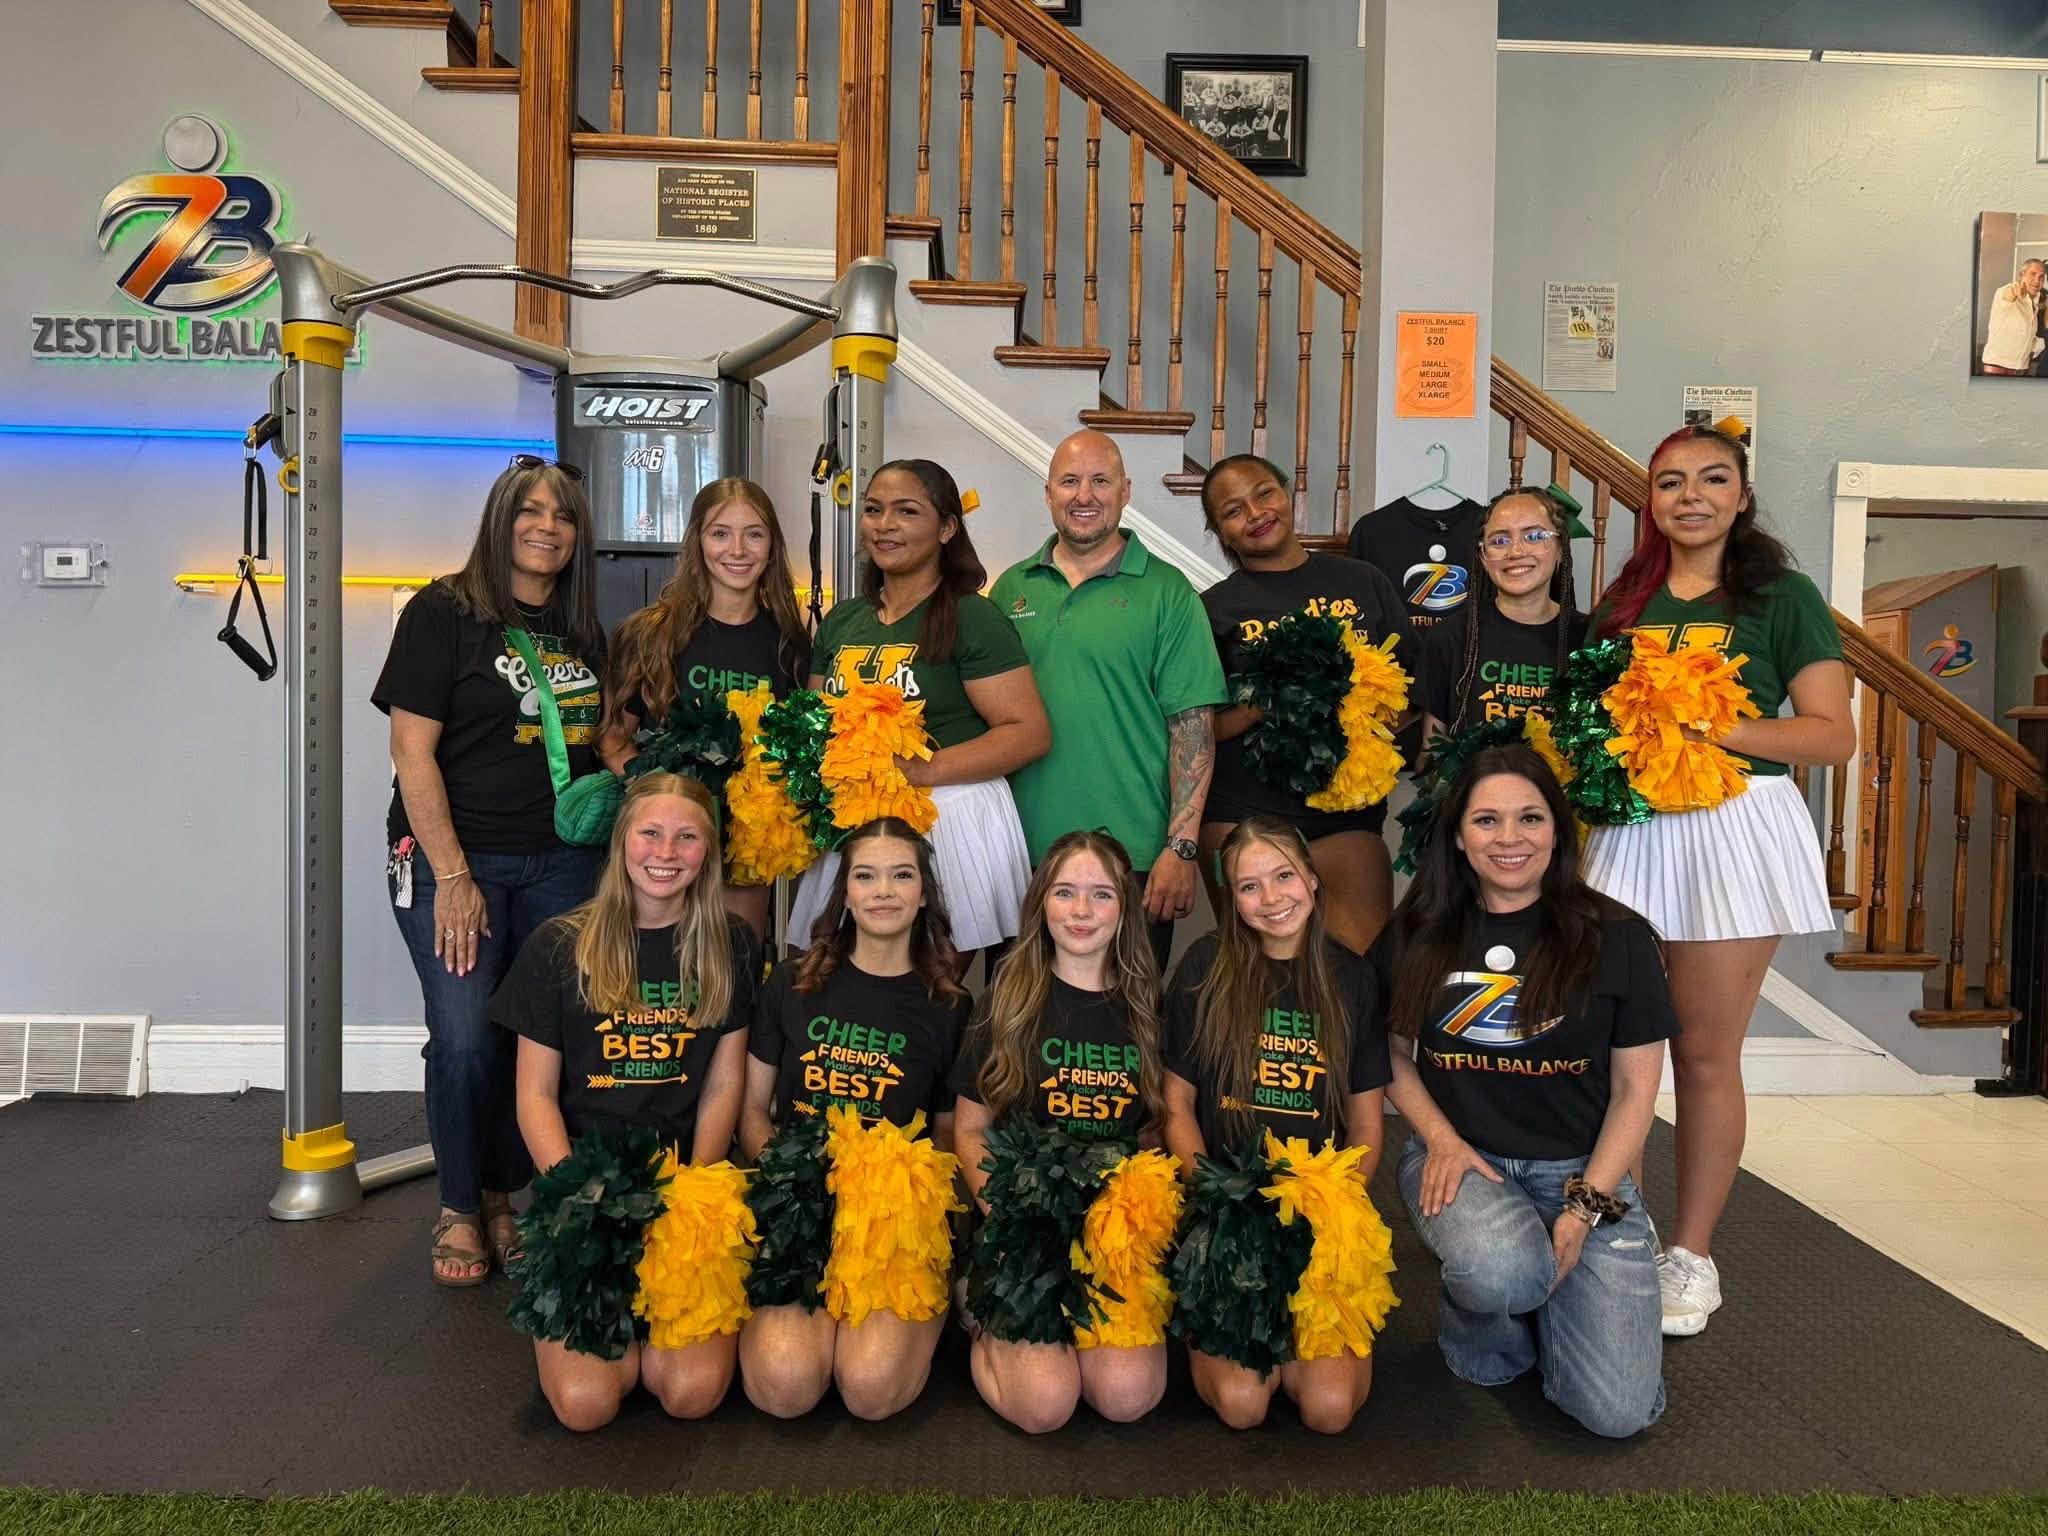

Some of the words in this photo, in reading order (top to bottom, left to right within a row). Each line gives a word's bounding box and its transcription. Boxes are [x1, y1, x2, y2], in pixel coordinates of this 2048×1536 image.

[664, 187, 706, 196] NATIONAL
[708, 189, 749, 197] REGISTER
[33, 315, 184, 354] ZESTFUL
[1426, 336, 1445, 346] $20
[1422, 360, 1448, 368] SMALL
[584, 396, 712, 420] HOIST
[308, 432, 317, 440] 27
[624, 446, 665, 472] Mi6
[308, 504, 317, 512] 24
[308, 552, 317, 560] 22
[1480, 661, 1554, 685] CHEE
[614, 1007, 688, 1025] FRIENDS
[623, 1025, 654, 1034] Make
[807, 1016, 907, 1055] CHEER
[603, 1033, 696, 1059] BEST
[818, 1043, 889, 1068] FRIENDS
[1042, 1038, 1140, 1073] CHEER
[1260, 1033, 1318, 1056] RIENDS
[1262, 1051, 1285, 1061] ake
[1425, 1048, 1494, 1072] STFUL
[1498, 1057, 1592, 1076] BALANCE
[611, 1060, 681, 1077] FRIENDS
[824, 1059, 856, 1073] Make
[864, 1067, 883, 1076] the
[1059, 1067, 1128, 1088] FRIENDS
[1260, 1058, 1328, 1091] EST
[805, 1065, 899, 1100] BEST
[1047, 1091, 1132, 1120] BEST
[1255, 1087, 1313, 1108] RIENDS
